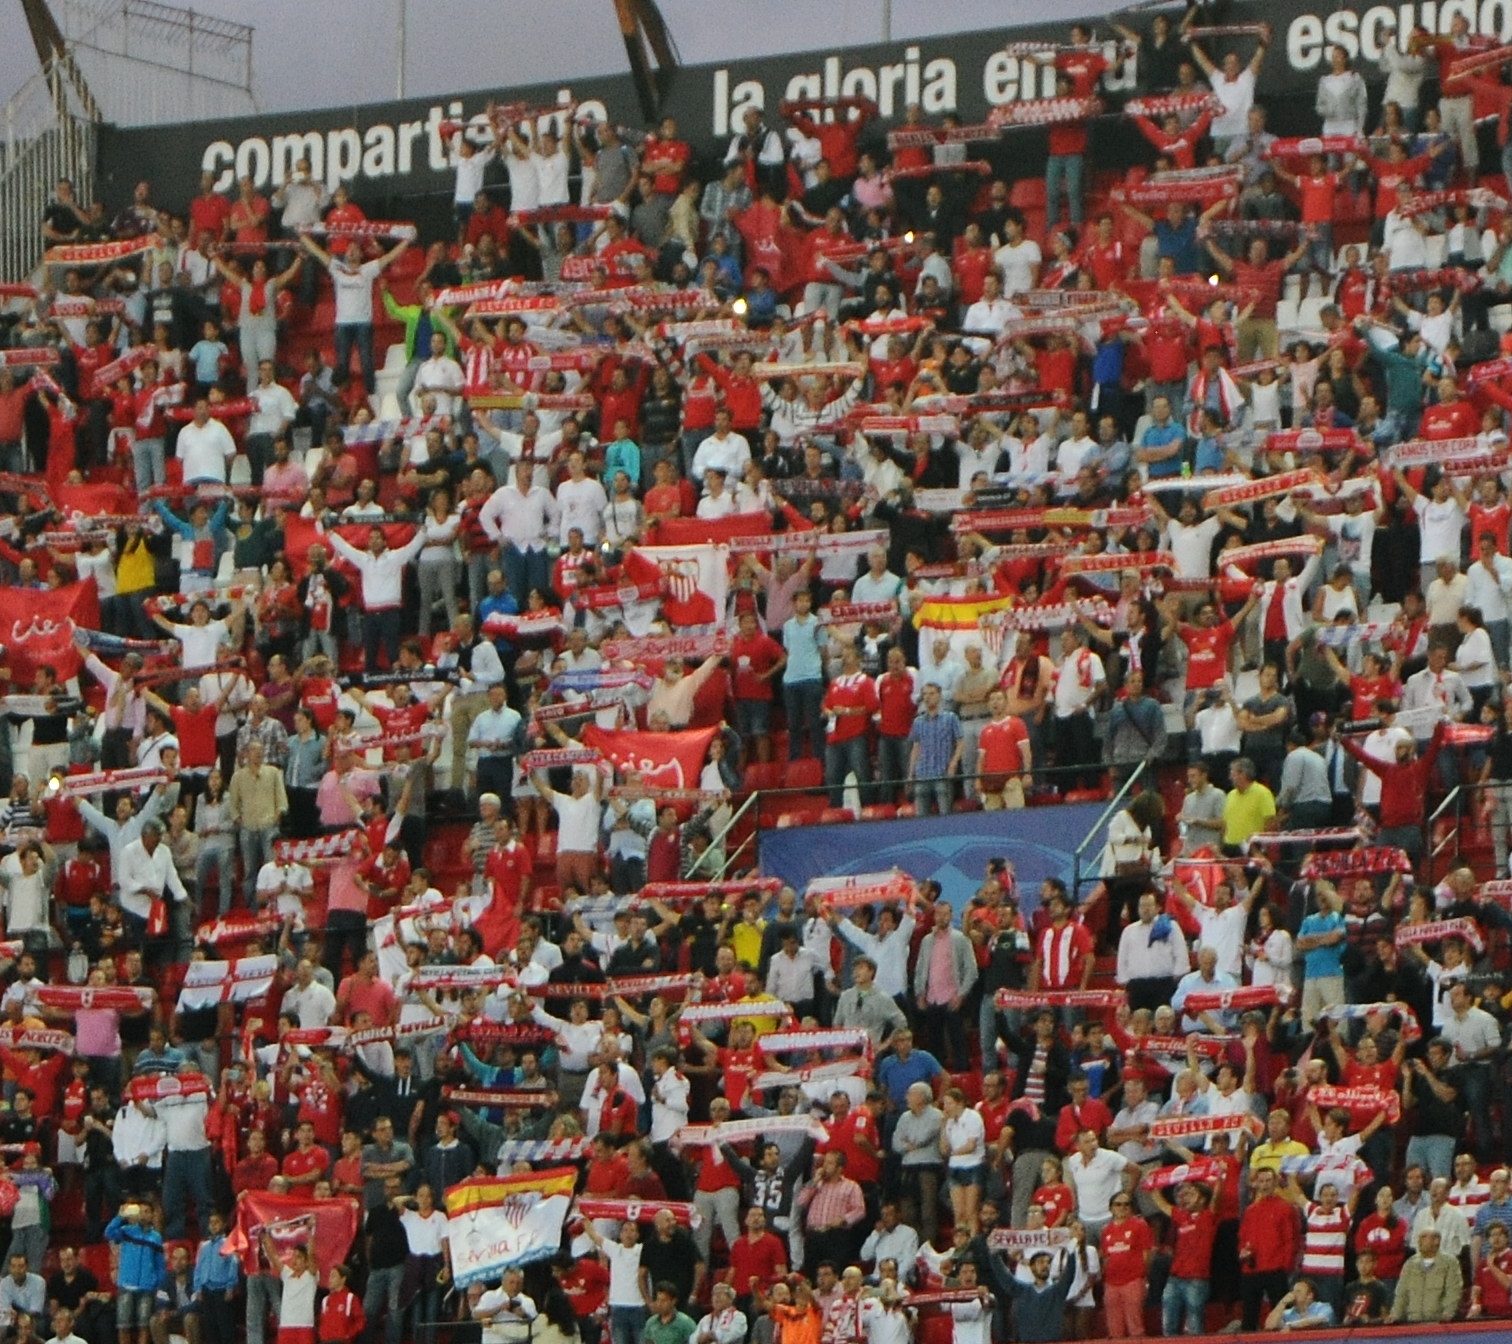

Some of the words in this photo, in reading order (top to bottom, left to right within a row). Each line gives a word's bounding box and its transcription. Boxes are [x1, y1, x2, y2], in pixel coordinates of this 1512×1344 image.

[714, 70, 766, 137] la
[546, 983, 601, 997] SEVILLA
[752, 1176, 782, 1208] 35
[993, 1232, 1030, 1245] SEVILLA
